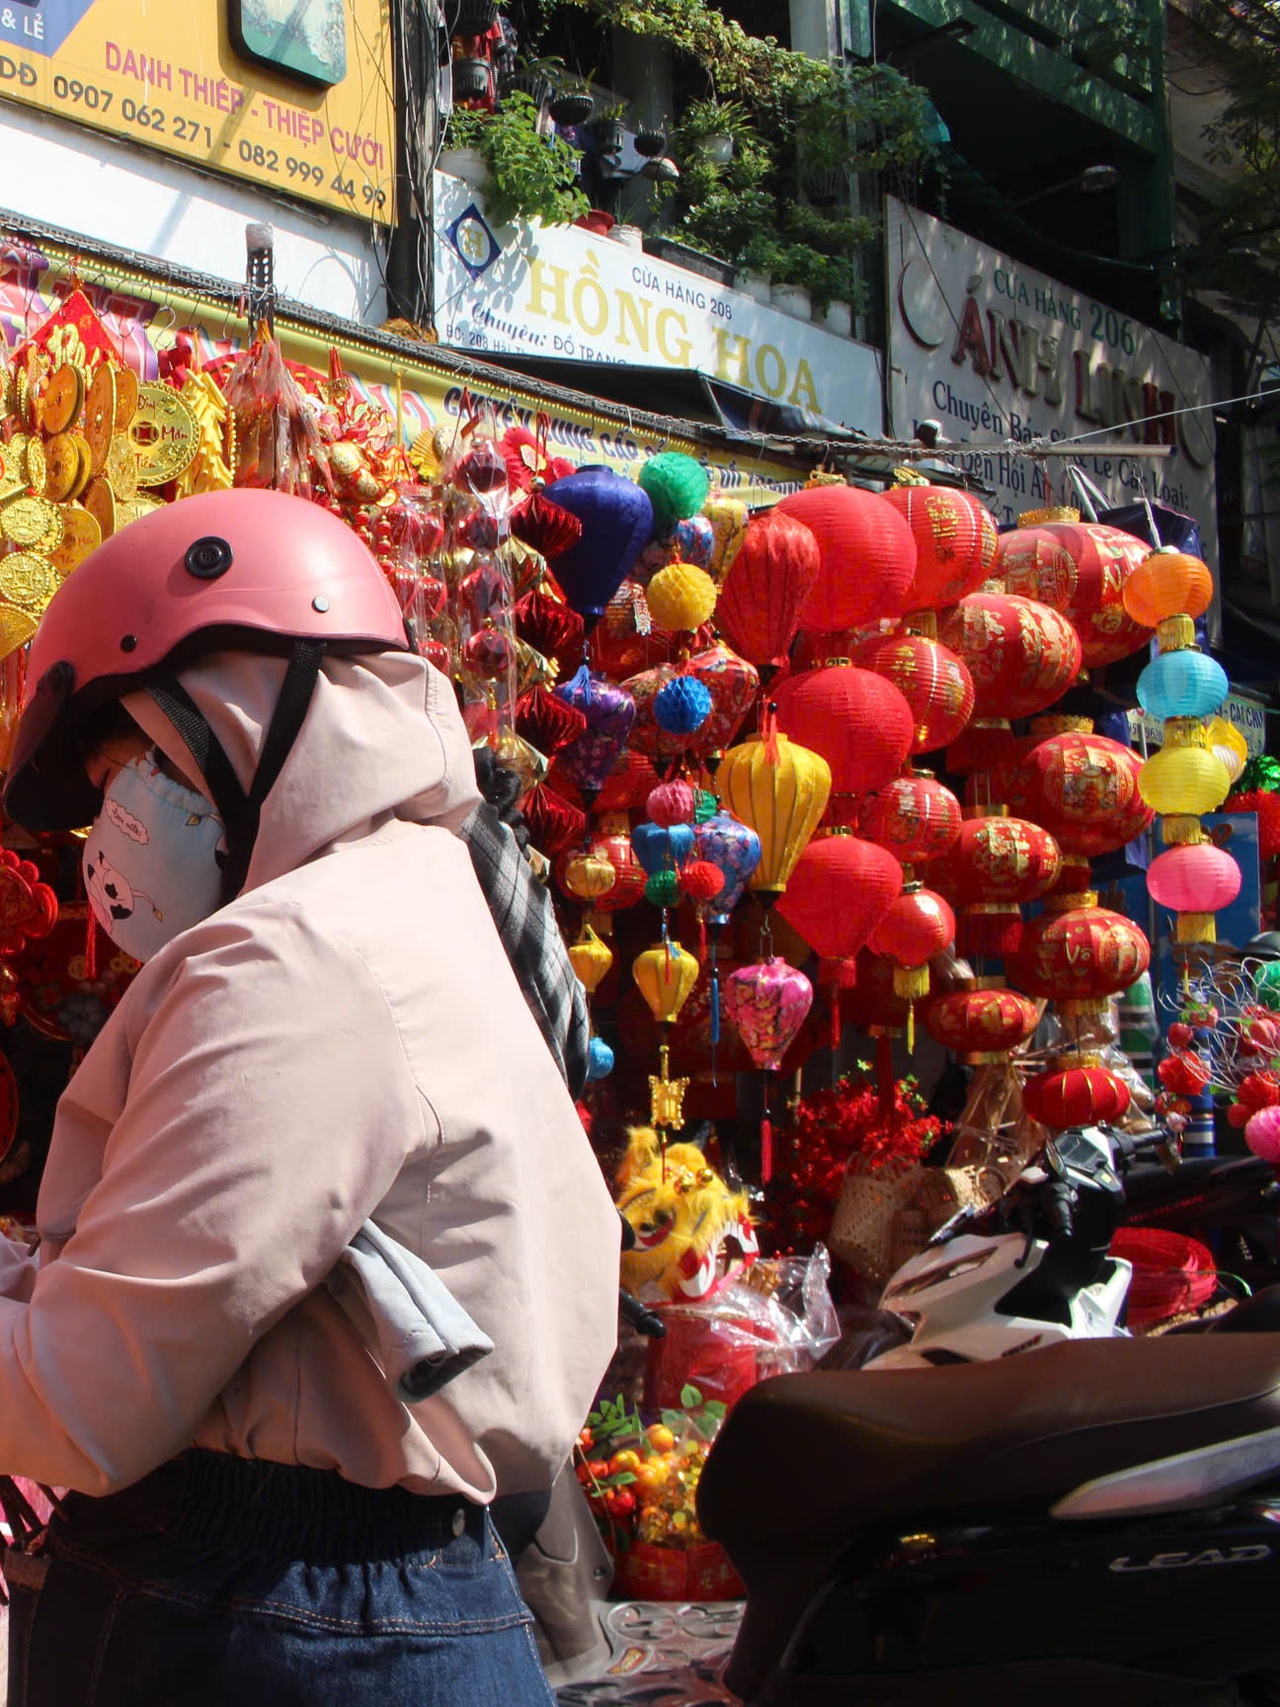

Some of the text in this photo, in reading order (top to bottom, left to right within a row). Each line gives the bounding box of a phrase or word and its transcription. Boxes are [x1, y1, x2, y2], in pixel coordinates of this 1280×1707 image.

[1, 8, 16, 30] &
[24, 13, 44, 40] LẺ
[106, 41, 172, 91] DANH
[179, 68, 245, 115] THIẾP
[263, 99, 325, 147] THIỆP
[330, 127, 384, 171] CƯỚI
[53, 75, 113, 113] 0907
[122, 98, 165, 133] 062
[173, 116, 212, 148] 271
[239, 139, 279, 172] 082
[285, 157, 324, 187] 999
[330, 174, 356, 199] 44
[361, 184, 387, 208] 99
[632, 264, 733, 320] CỬA HÀNG 208
[525, 249, 822, 414] HỒNG HOA
[1090, 303, 1135, 357] 206
[932, 380, 1003, 435] Chuyên
[1074, 350, 1177, 446] LINH
[1109, 1544, 1271, 1572] LEAD
